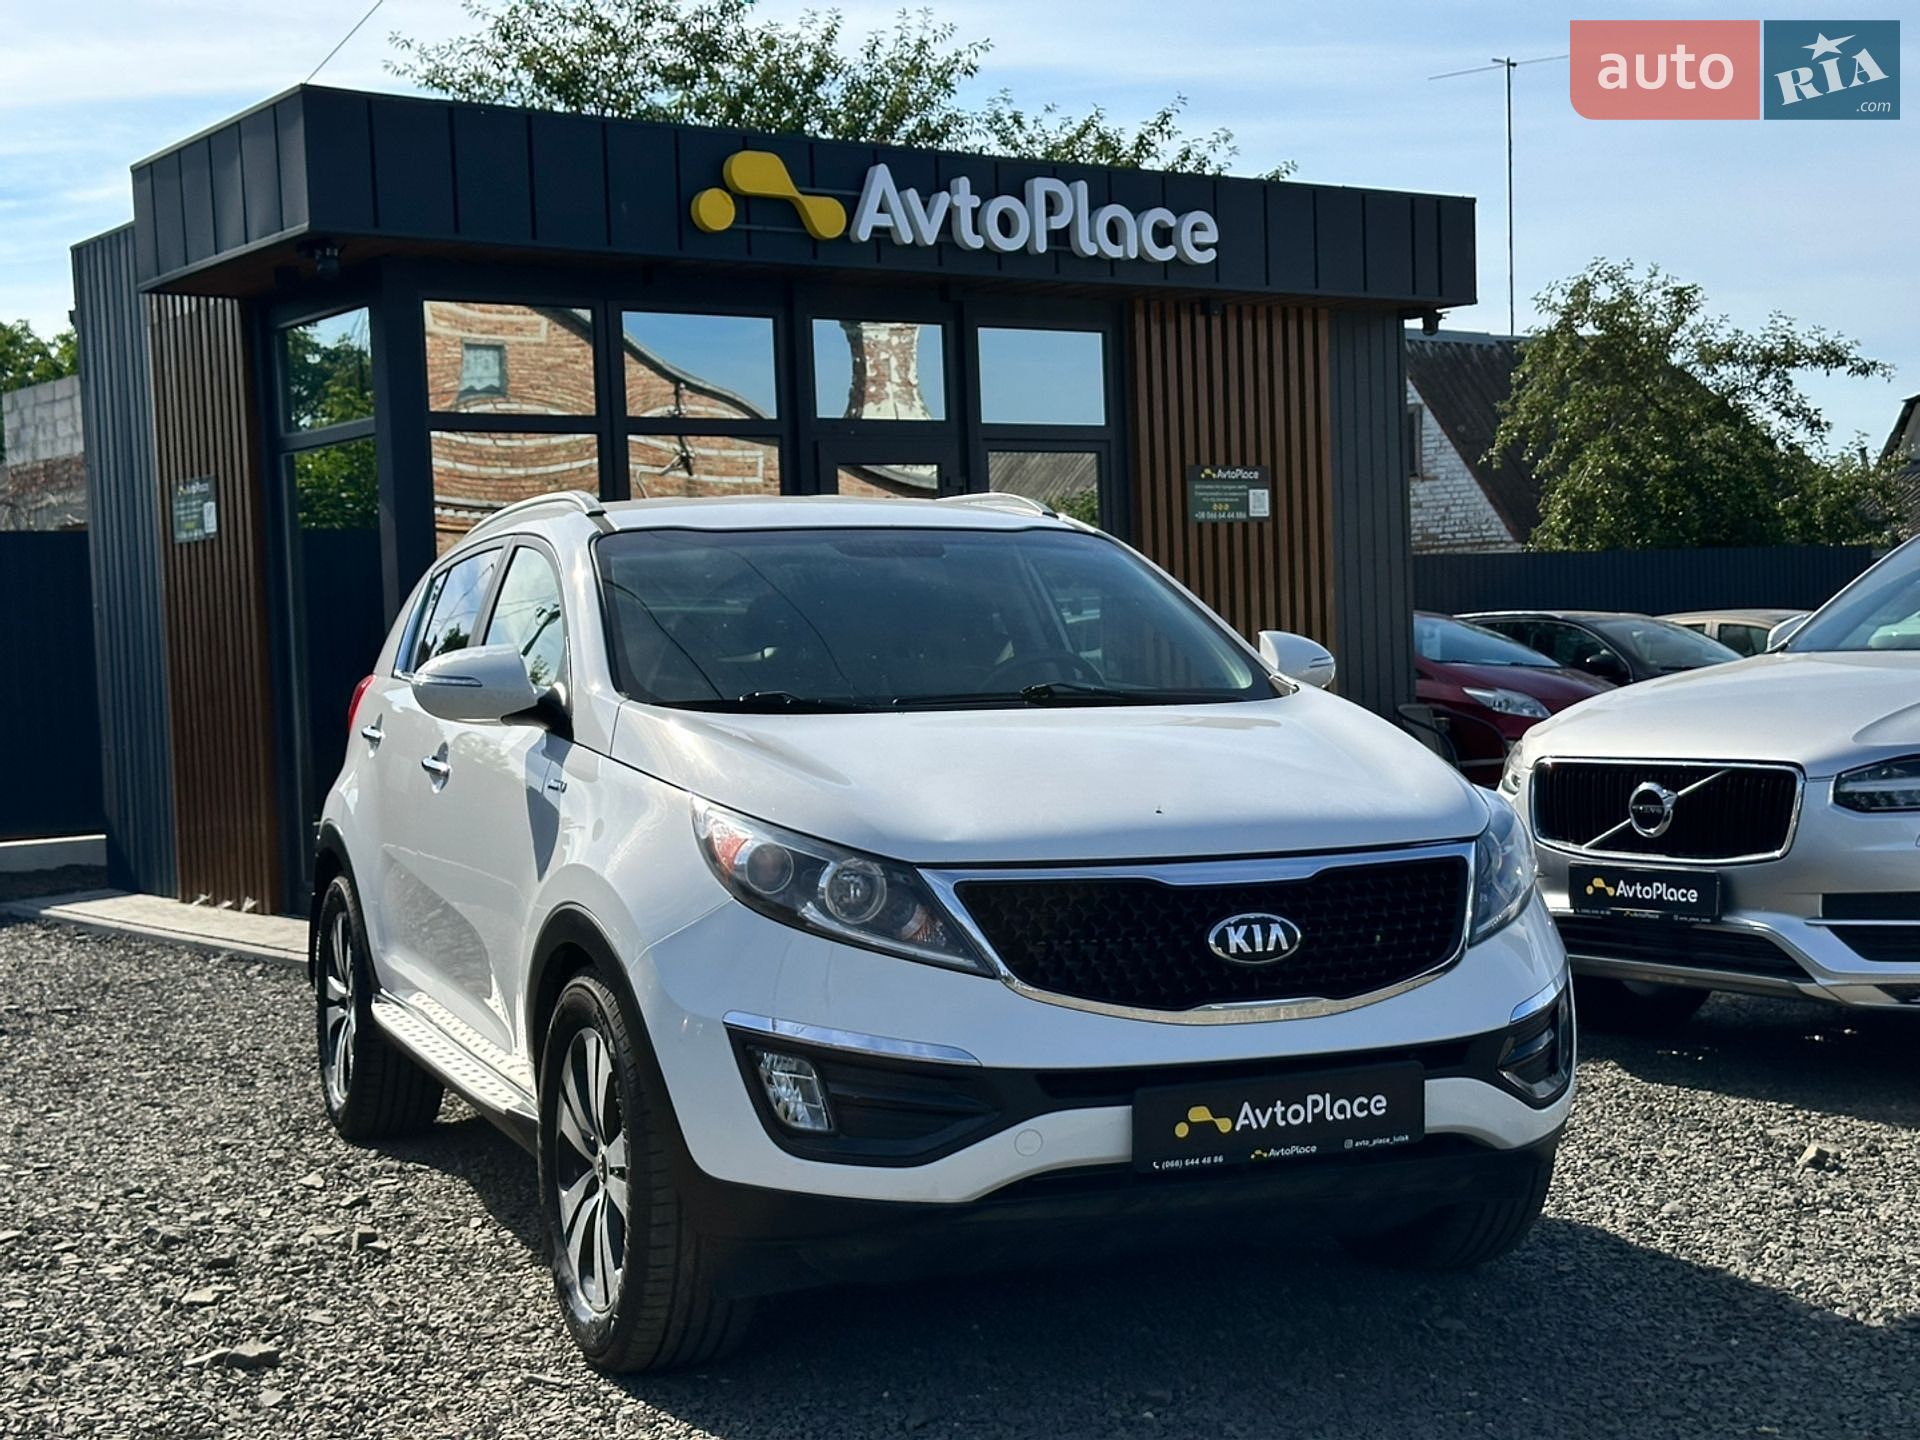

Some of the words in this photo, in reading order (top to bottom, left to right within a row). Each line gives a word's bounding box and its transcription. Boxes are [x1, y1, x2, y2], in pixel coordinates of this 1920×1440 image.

[849, 163, 1219, 265] AvtoPlace
[1217, 469, 1259, 480] AvtoPlace
[1616, 879, 1698, 903] AvtoPlace
[1225, 923, 1289, 954] KIA
[1235, 1093, 1387, 1131] AvtoPlace
[1268, 1145, 1317, 1157] AvtoPlace
